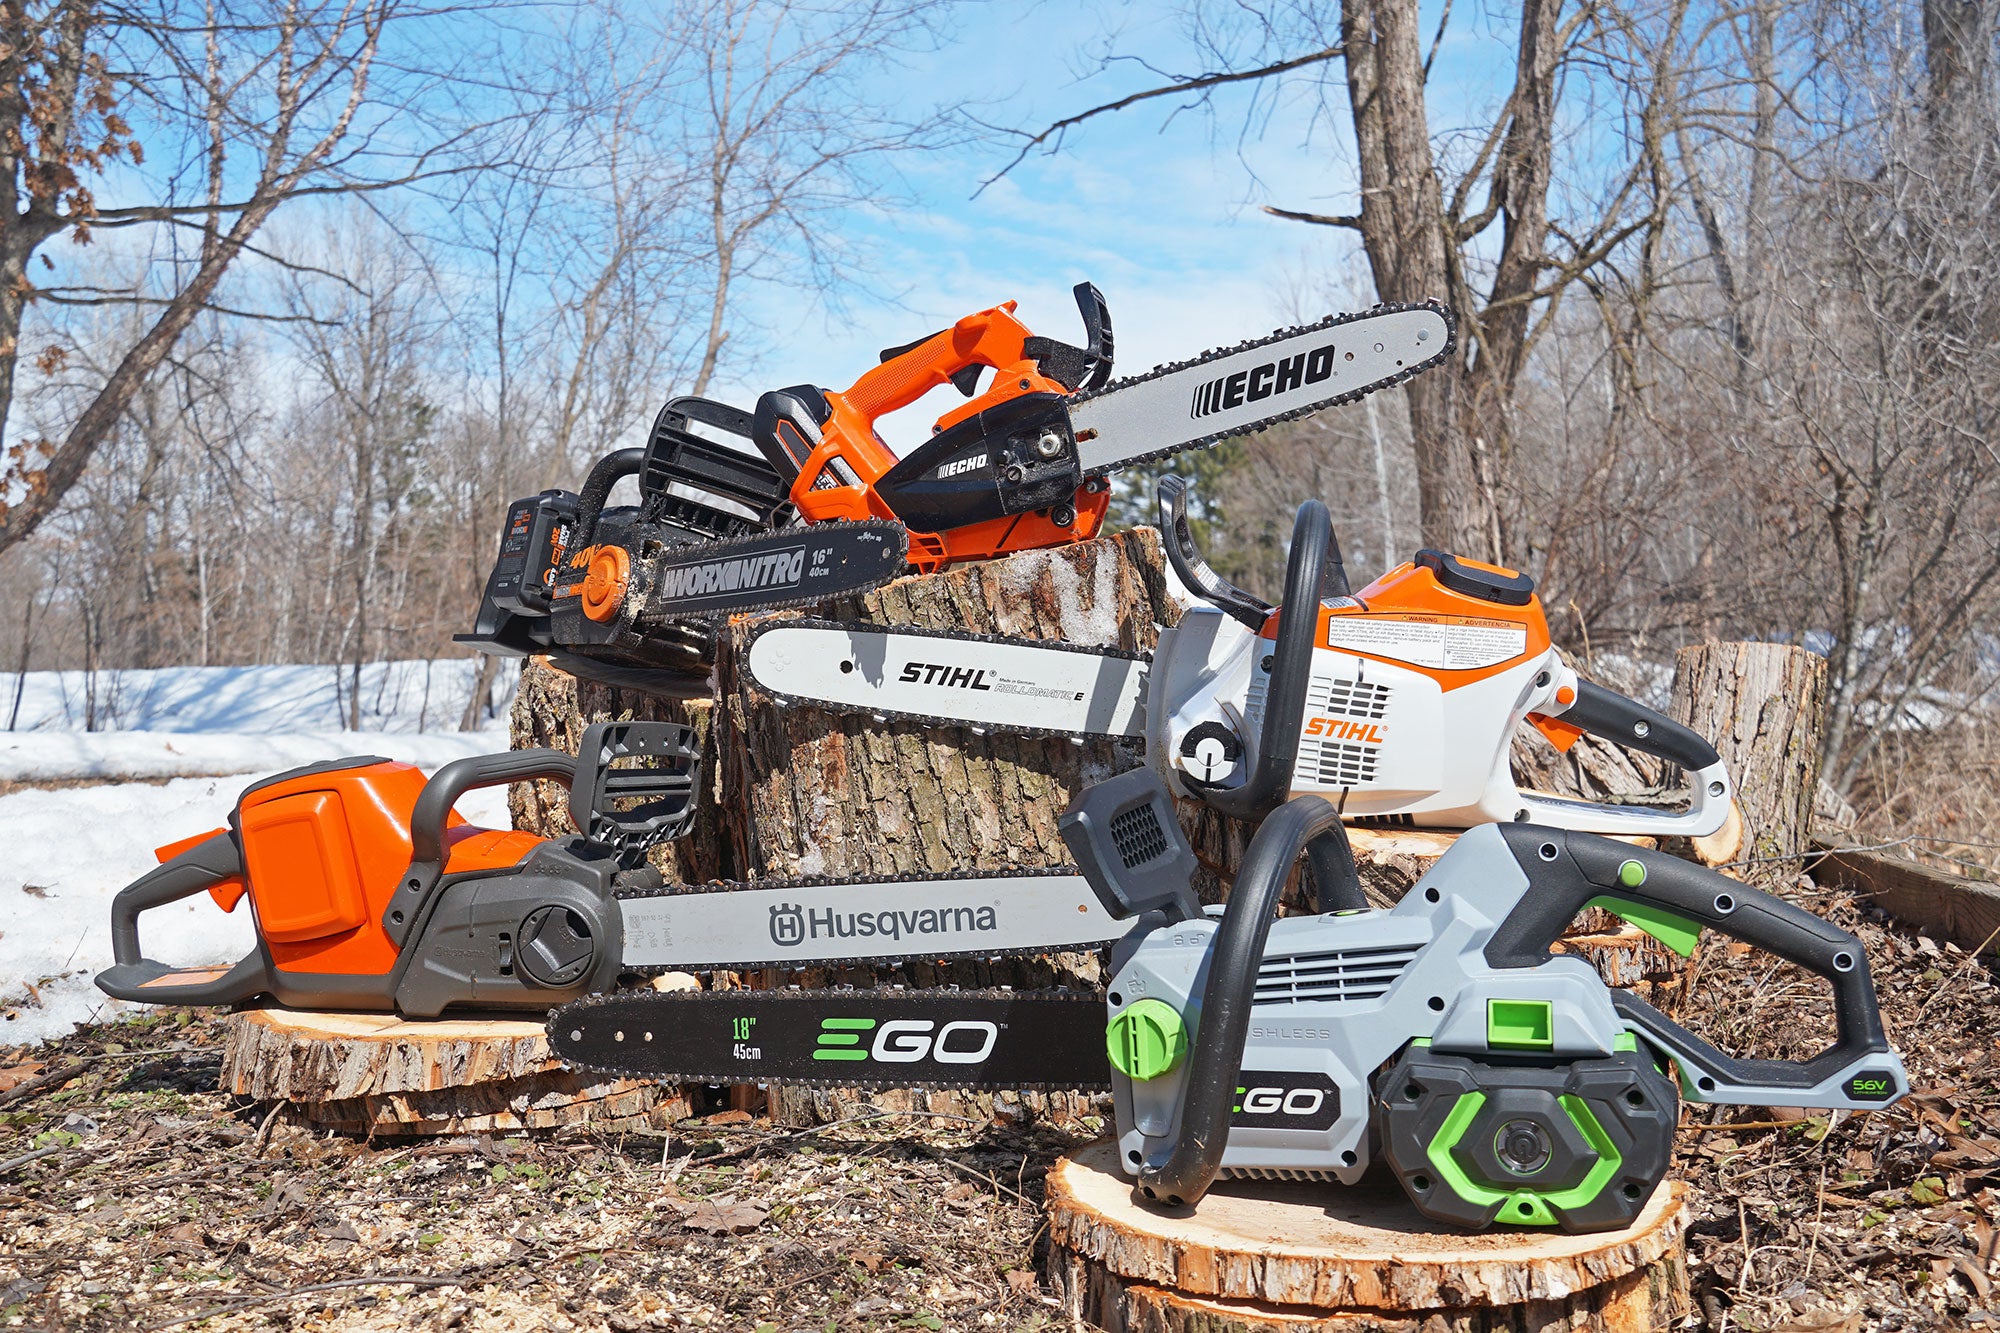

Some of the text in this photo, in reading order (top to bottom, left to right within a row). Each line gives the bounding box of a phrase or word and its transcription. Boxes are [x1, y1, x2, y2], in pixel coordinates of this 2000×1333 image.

[1221, 344, 1336, 410] ECHO
[944, 453, 988, 478] ECHO
[811, 547, 833, 566] 16"
[663, 548, 804, 599] WORX NITRO
[1408, 615, 1438, 623] WARNING
[1465, 619, 1511, 628] ADVERTENCIA
[898, 662, 991, 691] STIHL
[994, 682, 1085, 701] ROLLOMATIC E
[1304, 717, 1384, 744] STIHL
[808, 905, 997, 940] Husqvarna
[732, 1017, 757, 1041] 18"
[812, 1018, 998, 1064] EGO
[1246, 1027, 1331, 1041] SHLESS
[733, 1043, 762, 1060] 45cm
[1853, 1080, 1887, 1090] 56V
